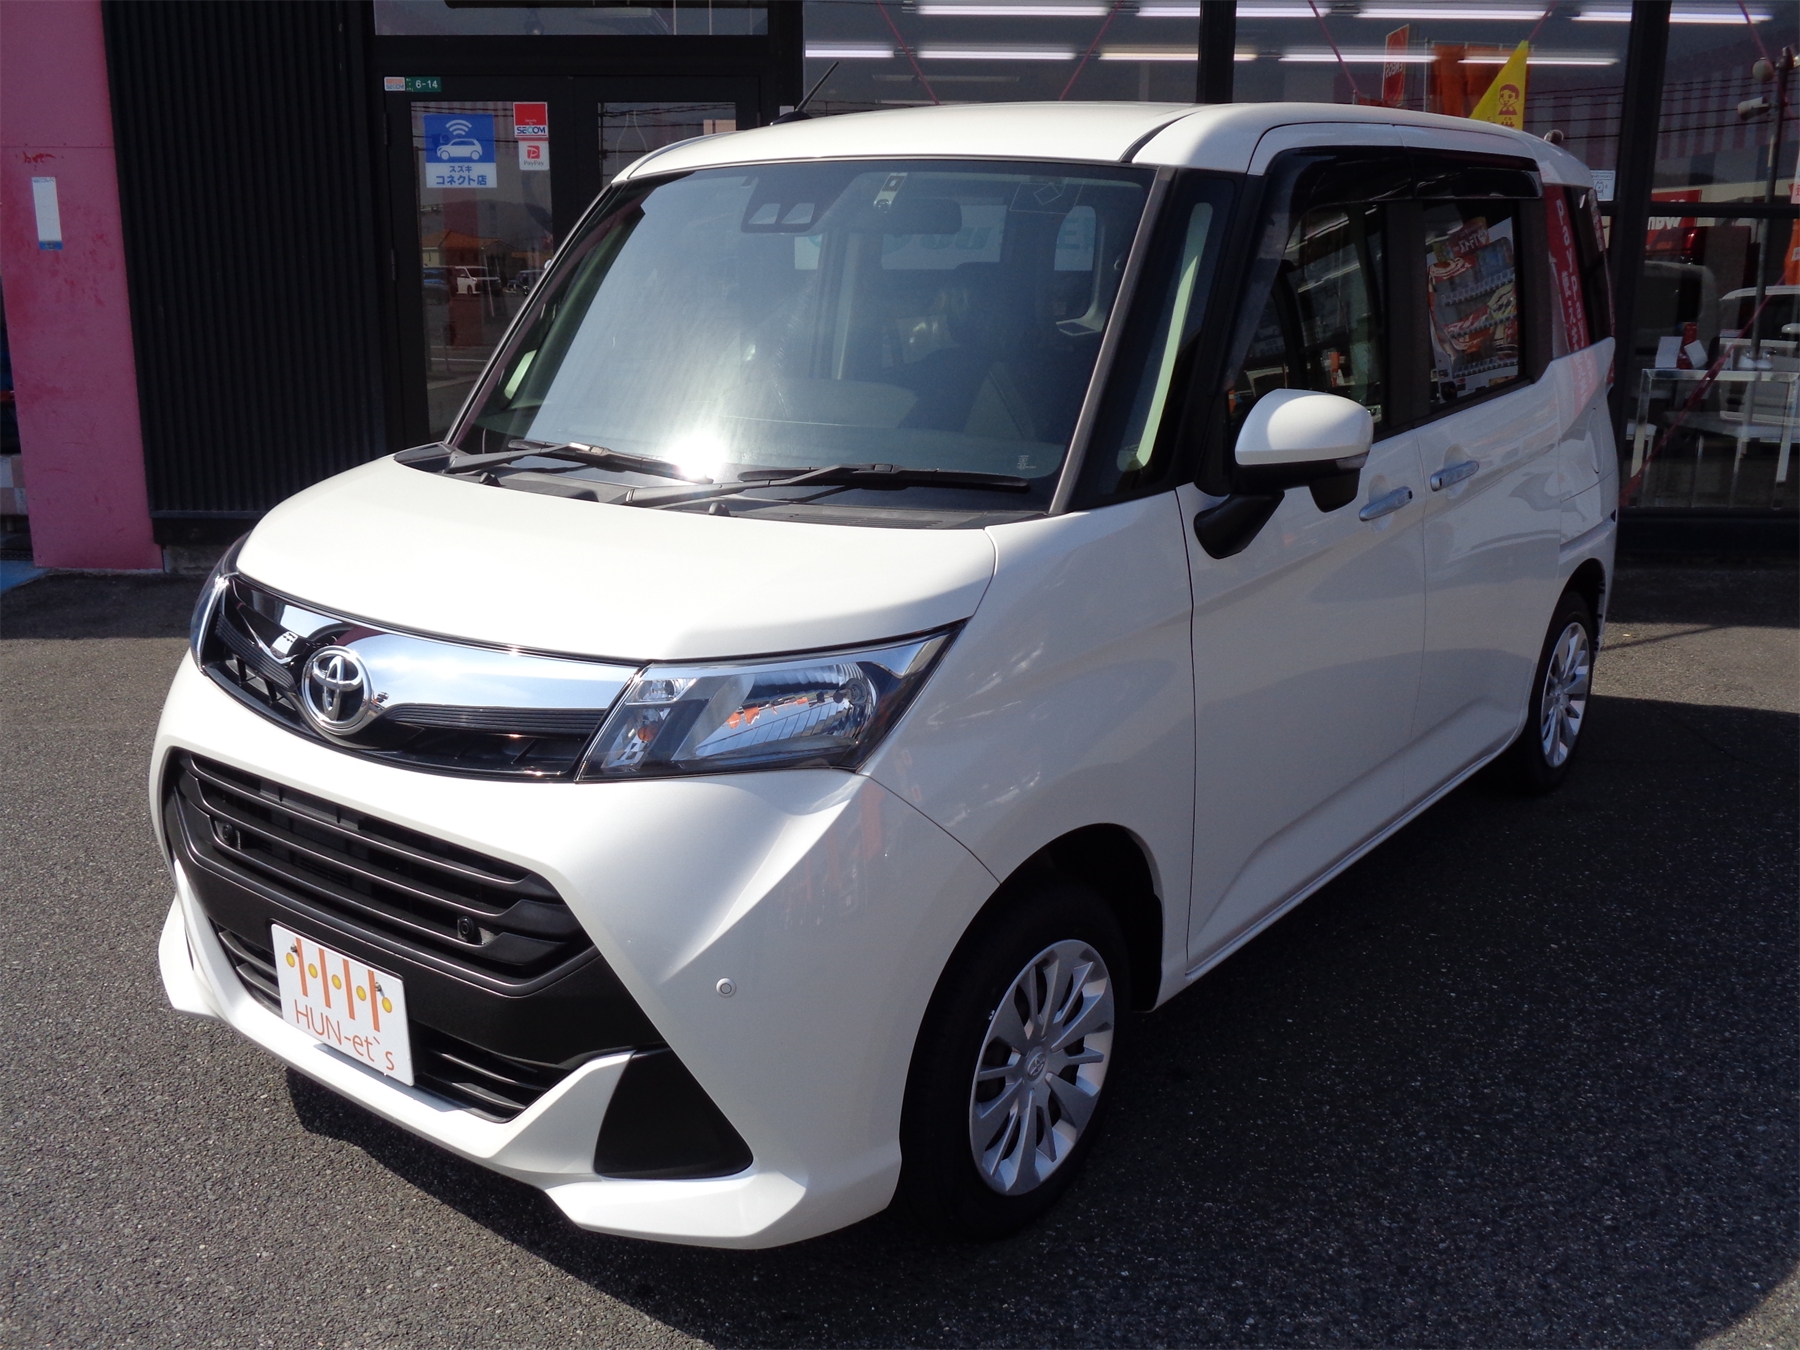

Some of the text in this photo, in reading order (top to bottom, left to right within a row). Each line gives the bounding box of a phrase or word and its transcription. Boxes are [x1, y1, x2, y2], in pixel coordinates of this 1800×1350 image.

[415, 79, 438, 89] 6-14
[516, 126, 546, 134] SECOM
[523, 160, 544, 168] PayPay
[449, 165, 473, 174] スズキ
[435, 174, 487, 187] コネクト店
